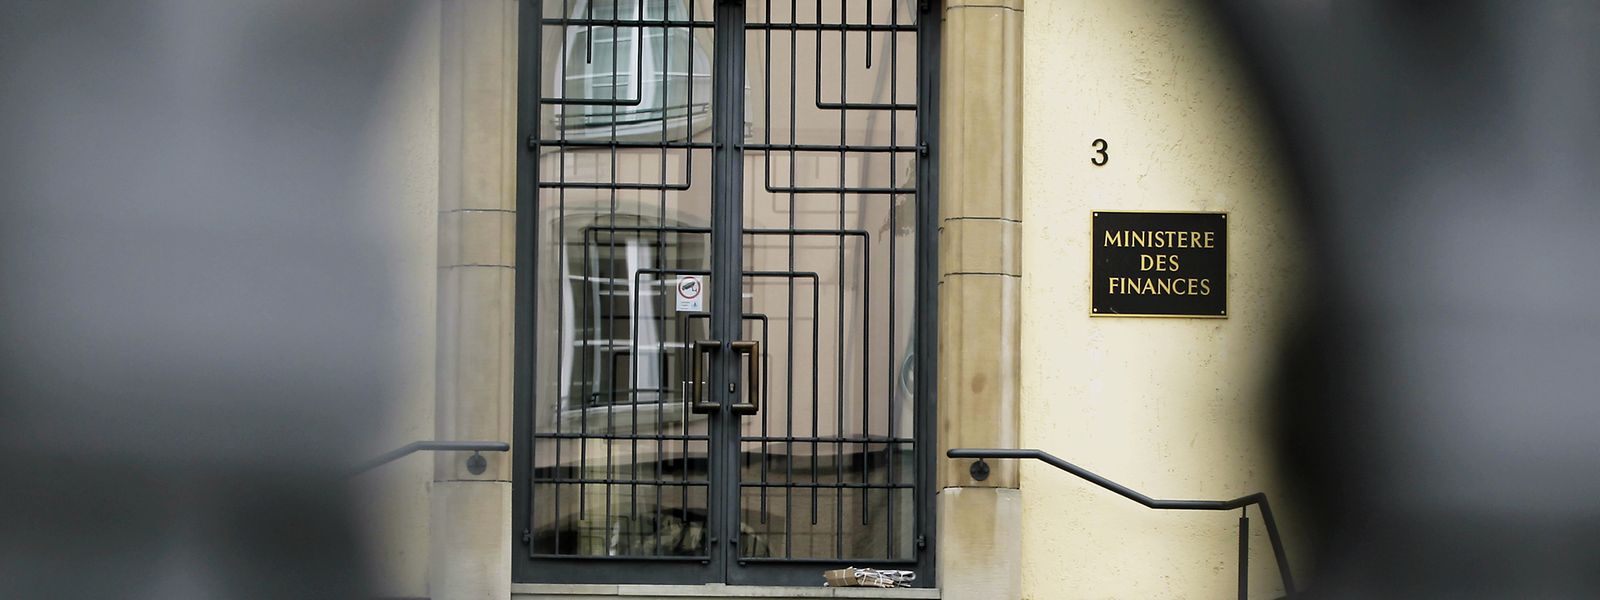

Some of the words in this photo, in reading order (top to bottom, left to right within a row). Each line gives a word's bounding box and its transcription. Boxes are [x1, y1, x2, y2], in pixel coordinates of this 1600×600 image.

[1091, 138, 1109, 167] 3
[1103, 230, 1215, 249] MINISTERE
[1140, 254, 1180, 272] DES
[1108, 277, 1211, 296] FINANCES
